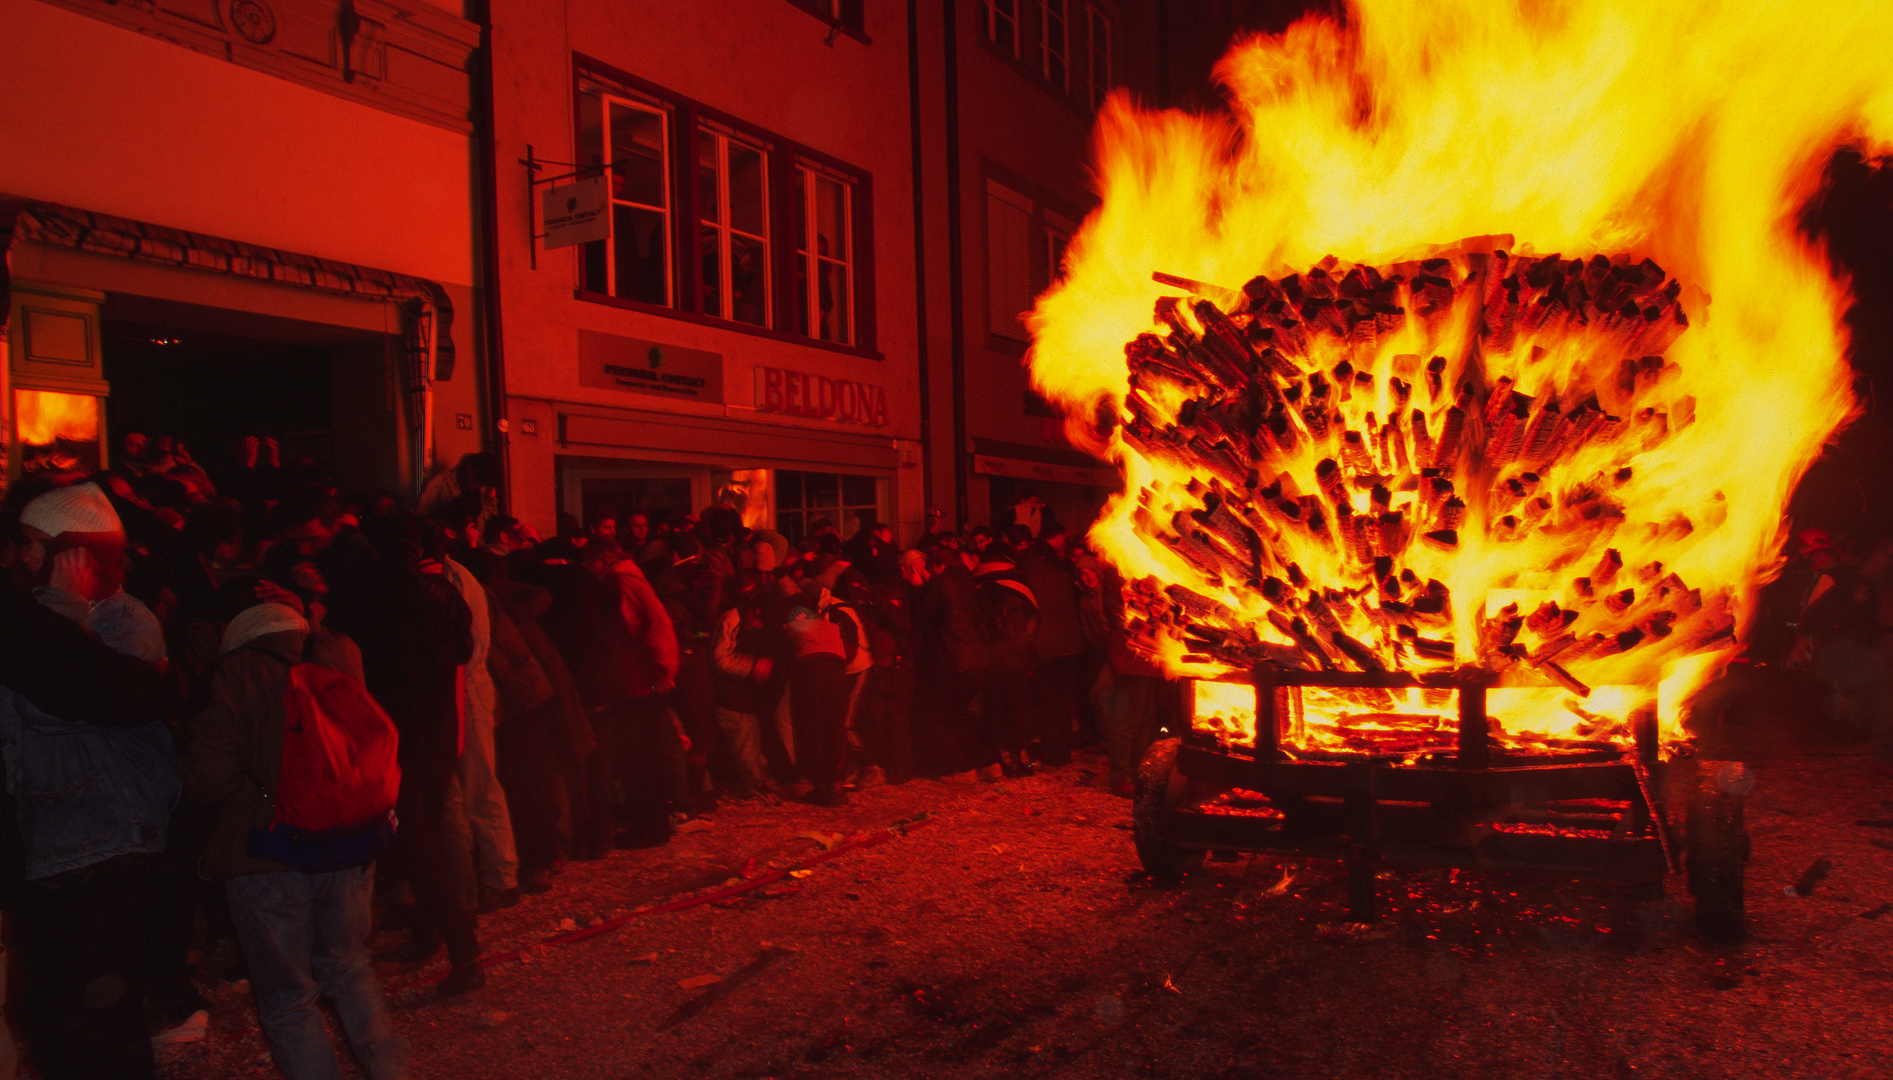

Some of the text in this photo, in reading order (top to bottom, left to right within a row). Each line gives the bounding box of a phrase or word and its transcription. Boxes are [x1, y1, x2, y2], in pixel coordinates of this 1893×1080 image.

[604, 364, 659, 382] PERSONAL
[661, 373, 706, 388] CONTACT
[764, 366, 889, 427] BELDONA
[457, 415, 470, 428] 70
